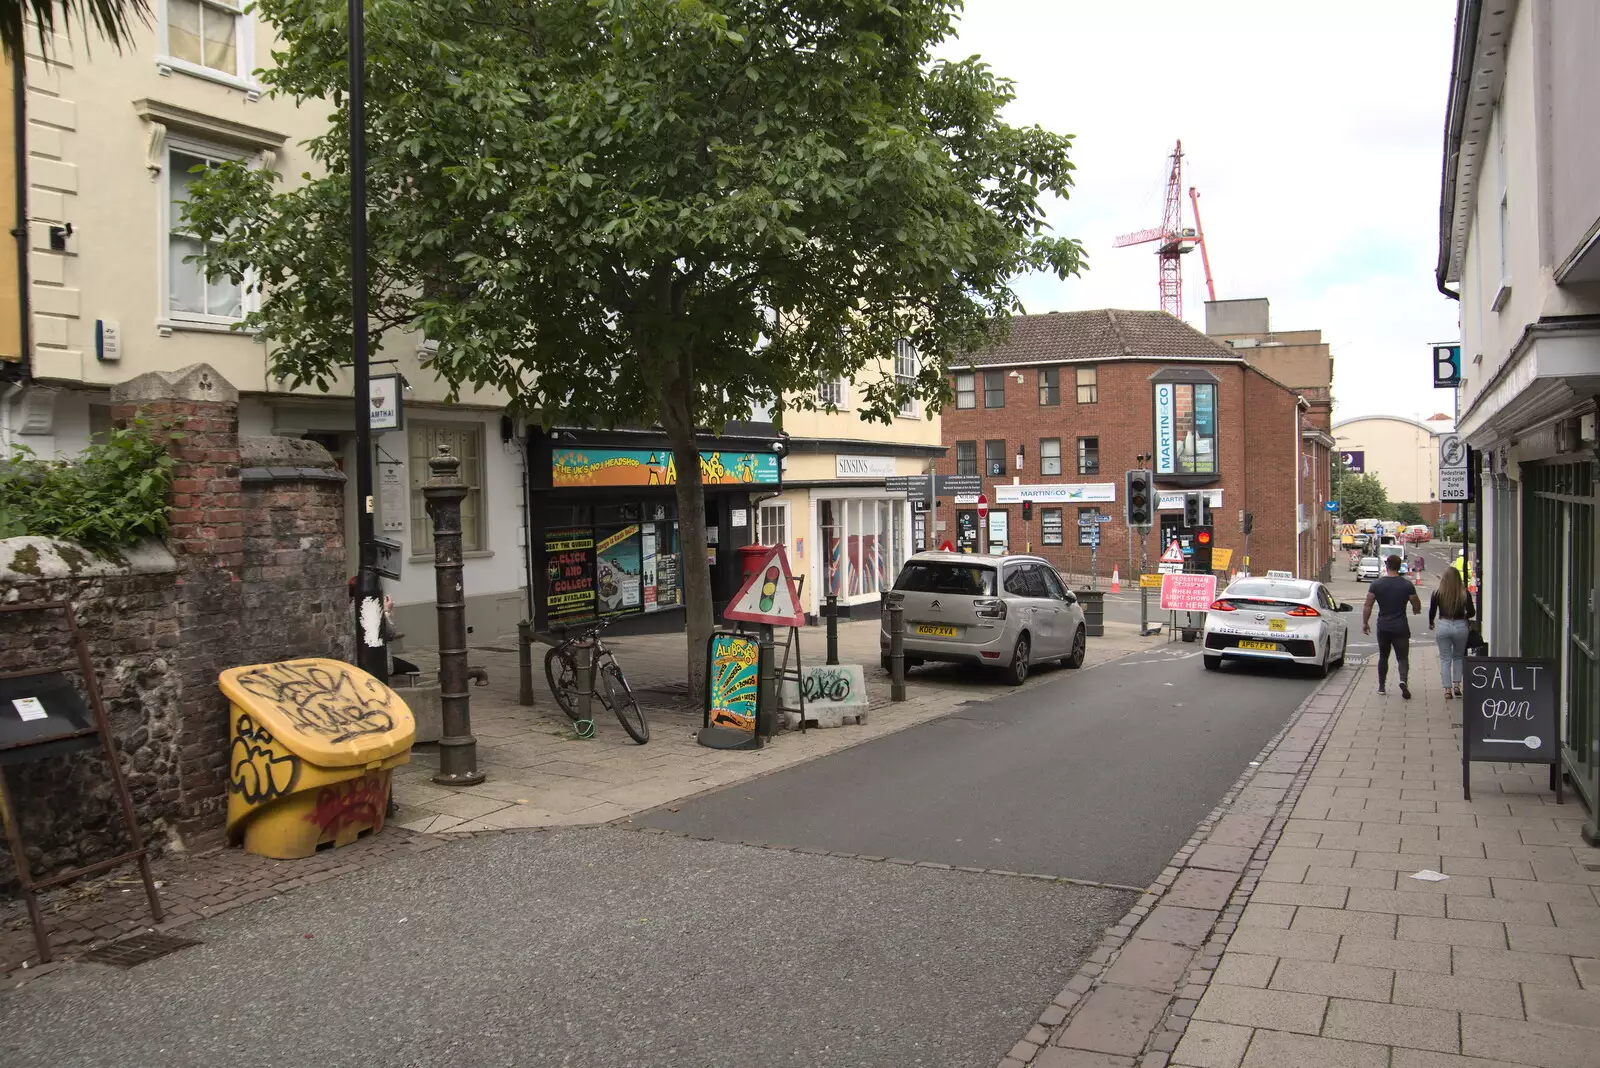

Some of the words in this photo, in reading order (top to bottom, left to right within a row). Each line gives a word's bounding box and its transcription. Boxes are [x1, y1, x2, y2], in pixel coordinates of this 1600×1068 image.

[1159, 387, 1171, 469] MARTIN&CO
[555, 463, 571, 474] THE
[604, 458, 640, 468] HEADSHOP
[768, 457, 777, 466] 22
[839, 459, 868, 473] SINSINS
[1442, 489, 1465, 498] ENDS
[560, 552, 586, 563] CLICK
[565, 566, 582, 577] AND
[555, 578, 593, 592] COLLECT
[1185, 601, 1208, 609] HERE
[1259, 642, 1273, 650] FXY
[739, 675, 755, 688] BONGS
[1471, 665, 1543, 691] SALT
